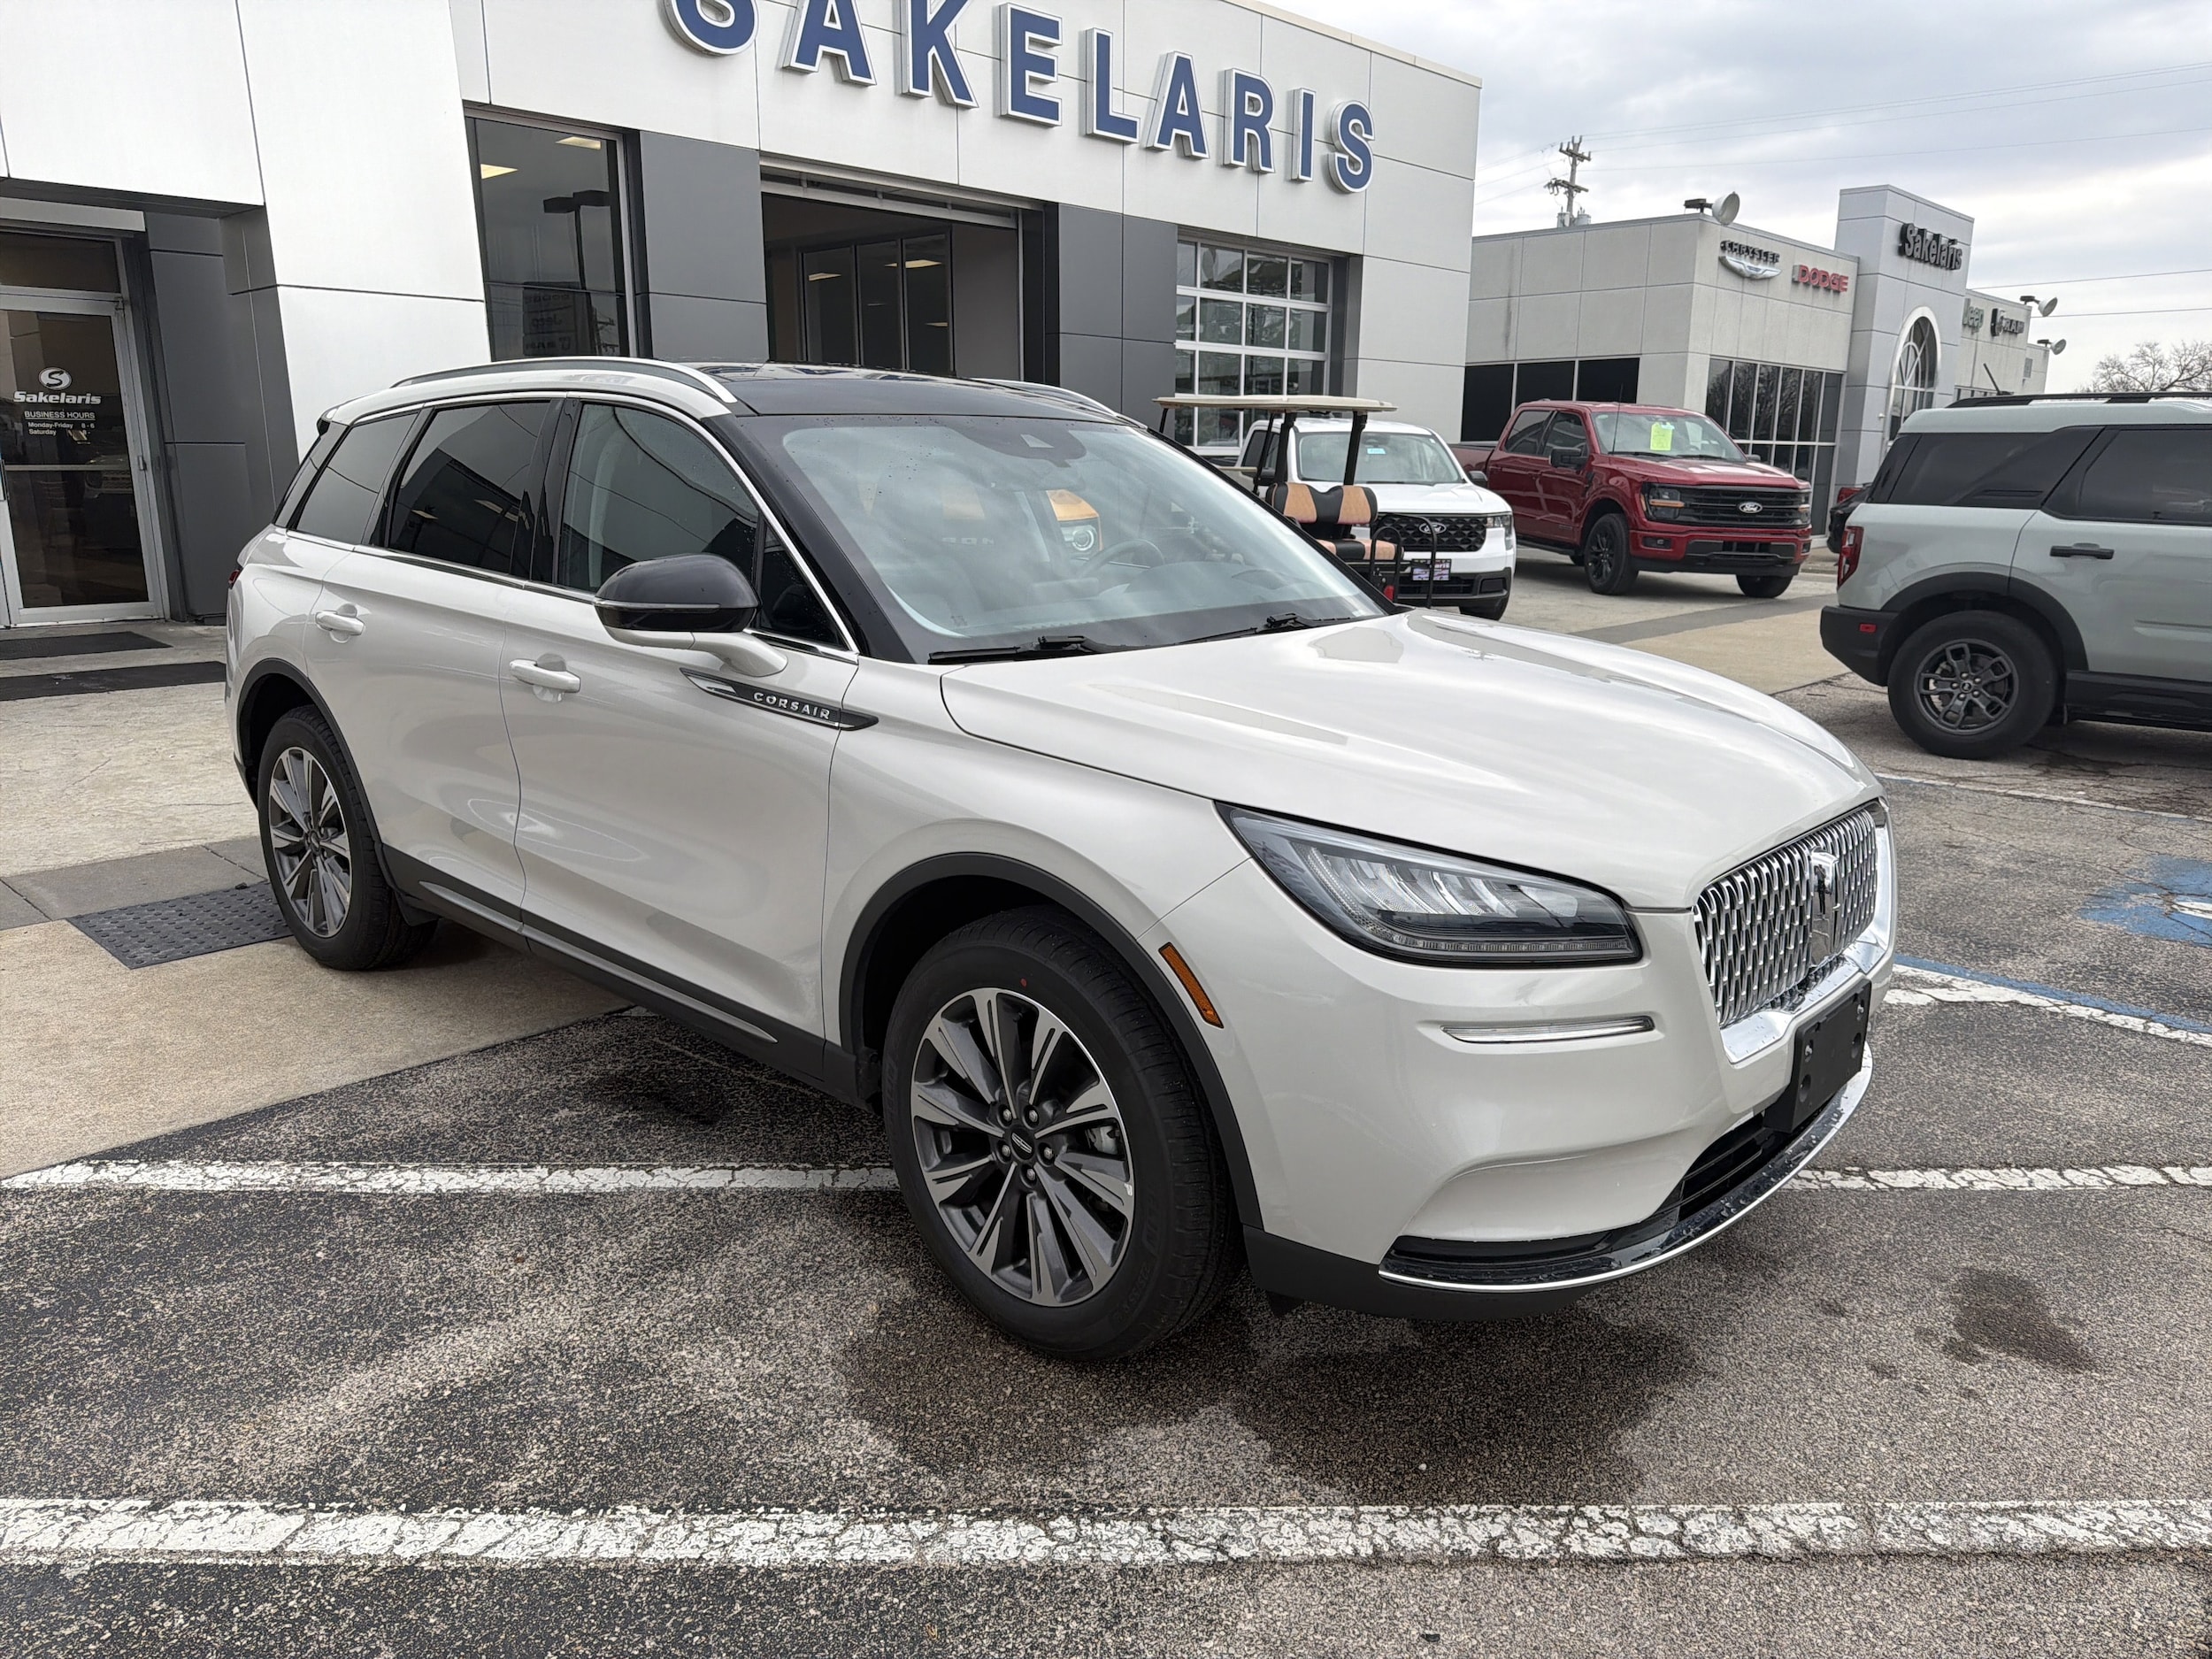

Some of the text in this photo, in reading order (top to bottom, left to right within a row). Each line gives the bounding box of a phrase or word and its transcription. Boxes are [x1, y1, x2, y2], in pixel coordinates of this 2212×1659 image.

[1721, 241, 1780, 263] CHRYSLER
[1903, 223, 1962, 270] Sakelaris
[1797, 265, 1848, 292] DODGE
[1962, 298, 1984, 333] Jeep
[13, 390, 102, 404] Sakelaris
[753, 691, 830, 720] CORSAIR
